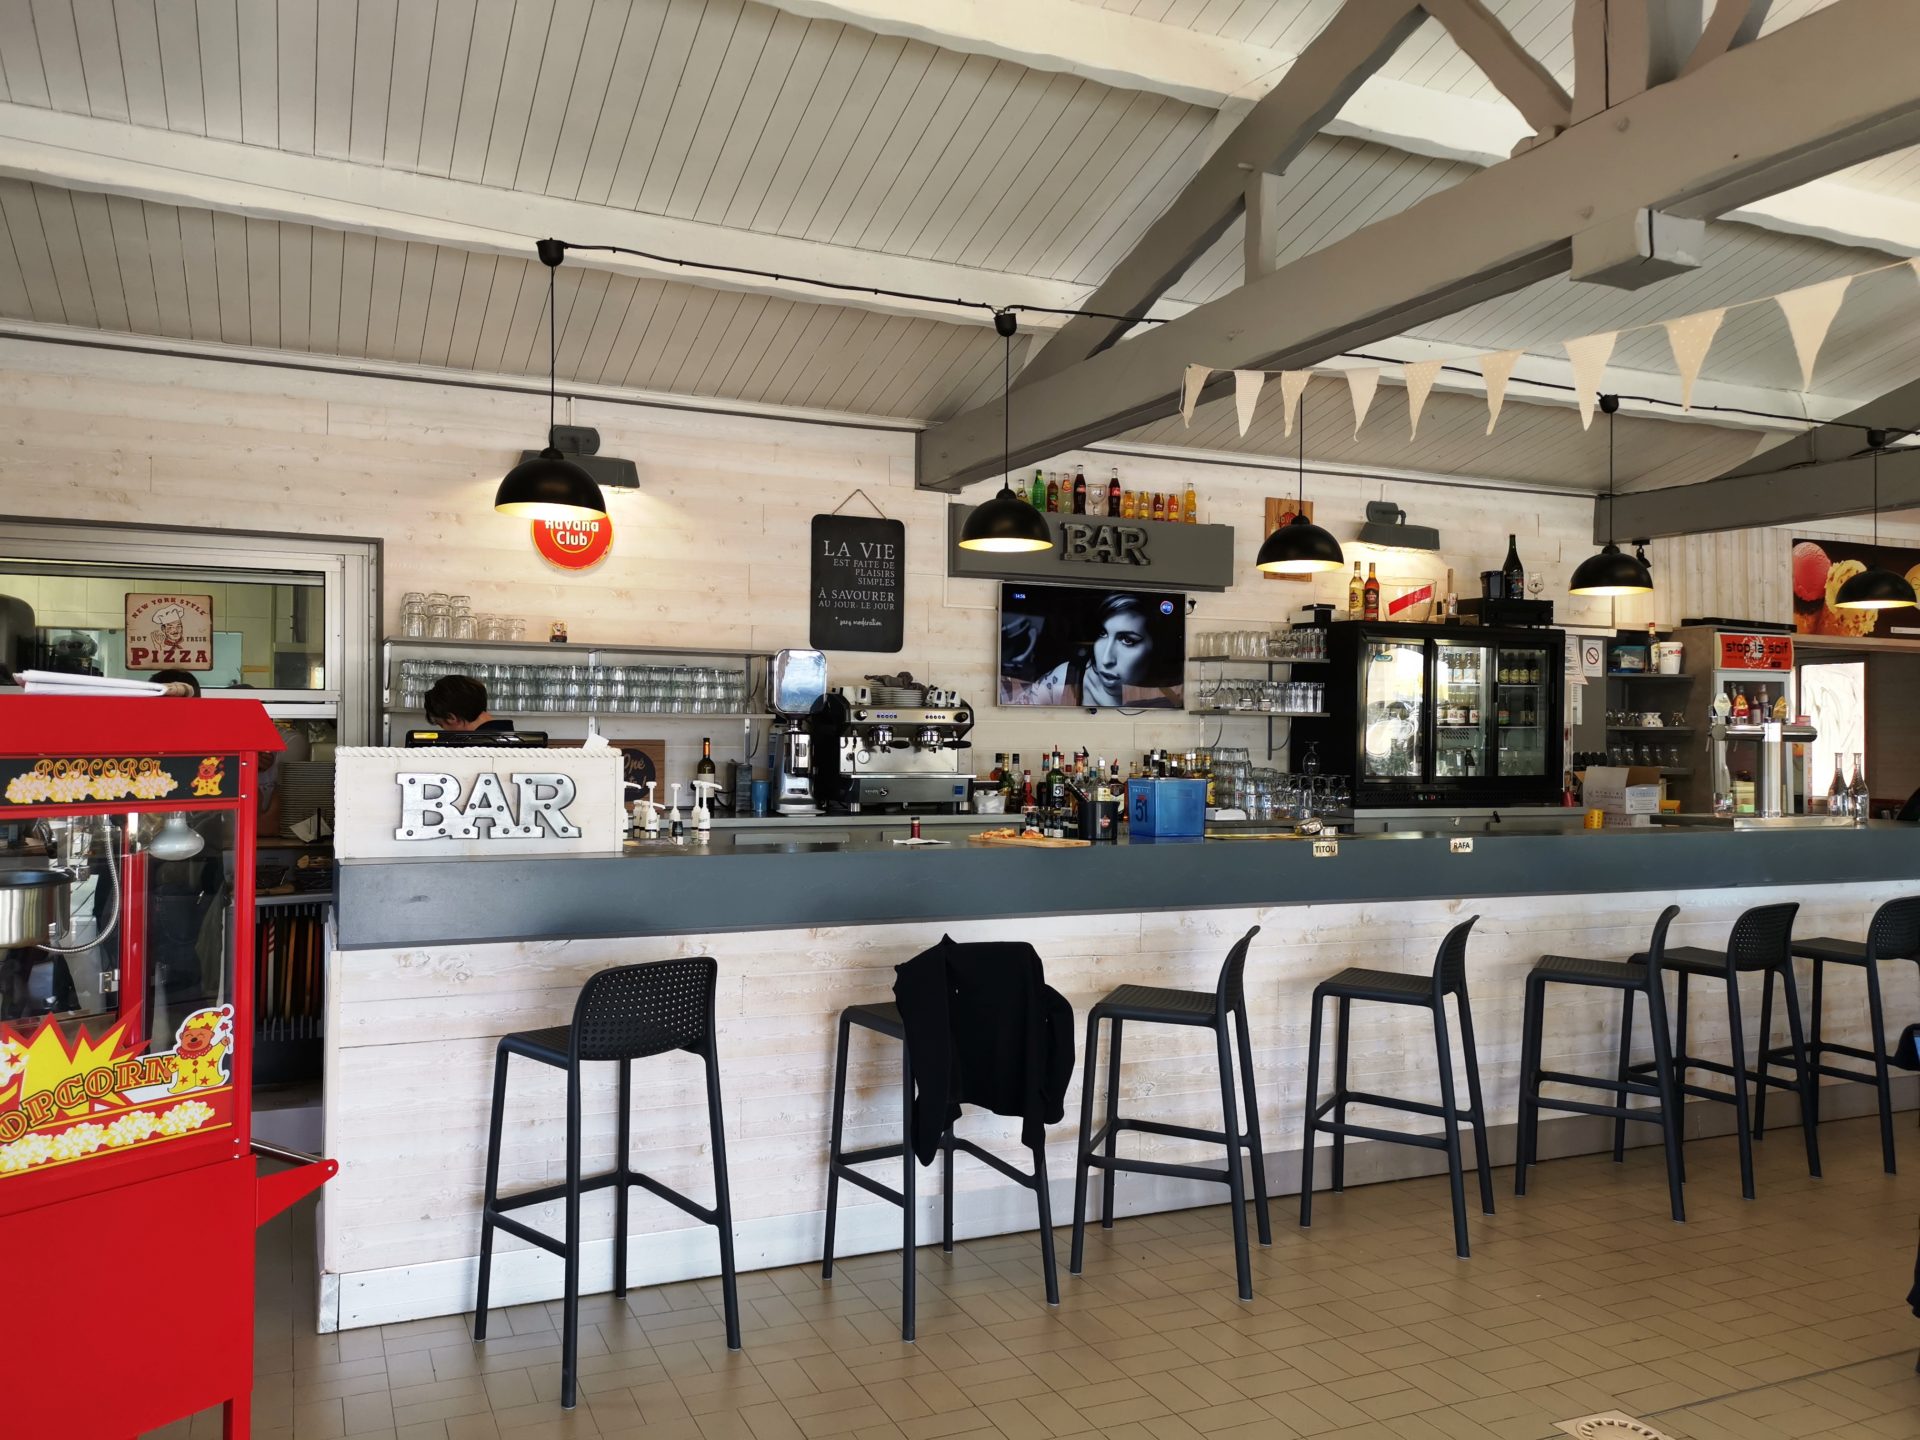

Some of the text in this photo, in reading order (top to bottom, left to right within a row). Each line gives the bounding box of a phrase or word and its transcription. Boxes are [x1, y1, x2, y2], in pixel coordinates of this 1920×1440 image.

[545, 519, 599, 532] Havana
[556, 531, 588, 546] Club
[1060, 522, 1151, 566] BAR
[824, 540, 895, 560] LA VIE
[833, 558, 895, 570] EST FAITE DE
[855, 569, 895, 578] PLAISIRS
[858, 578, 895, 587] SIMPLES
[818, 587, 895, 602] À SAVOURER
[132, 597, 209, 619] NEW YORK STYLE
[818, 600, 895, 611] AU JOUR LE JOUR
[1726, 641, 1750, 653] stop
[1768, 642, 1788, 654] soif
[130, 647, 208, 666] PIZZA
[34, 758, 162, 780] POPCORN
[395, 772, 582, 841] BAR
[1135, 797, 1148, 823] 51
[1315, 844, 1336, 853] TITOU
[1453, 842, 1471, 850] RAFA
[0, 1054, 177, 1143] OPCORN
